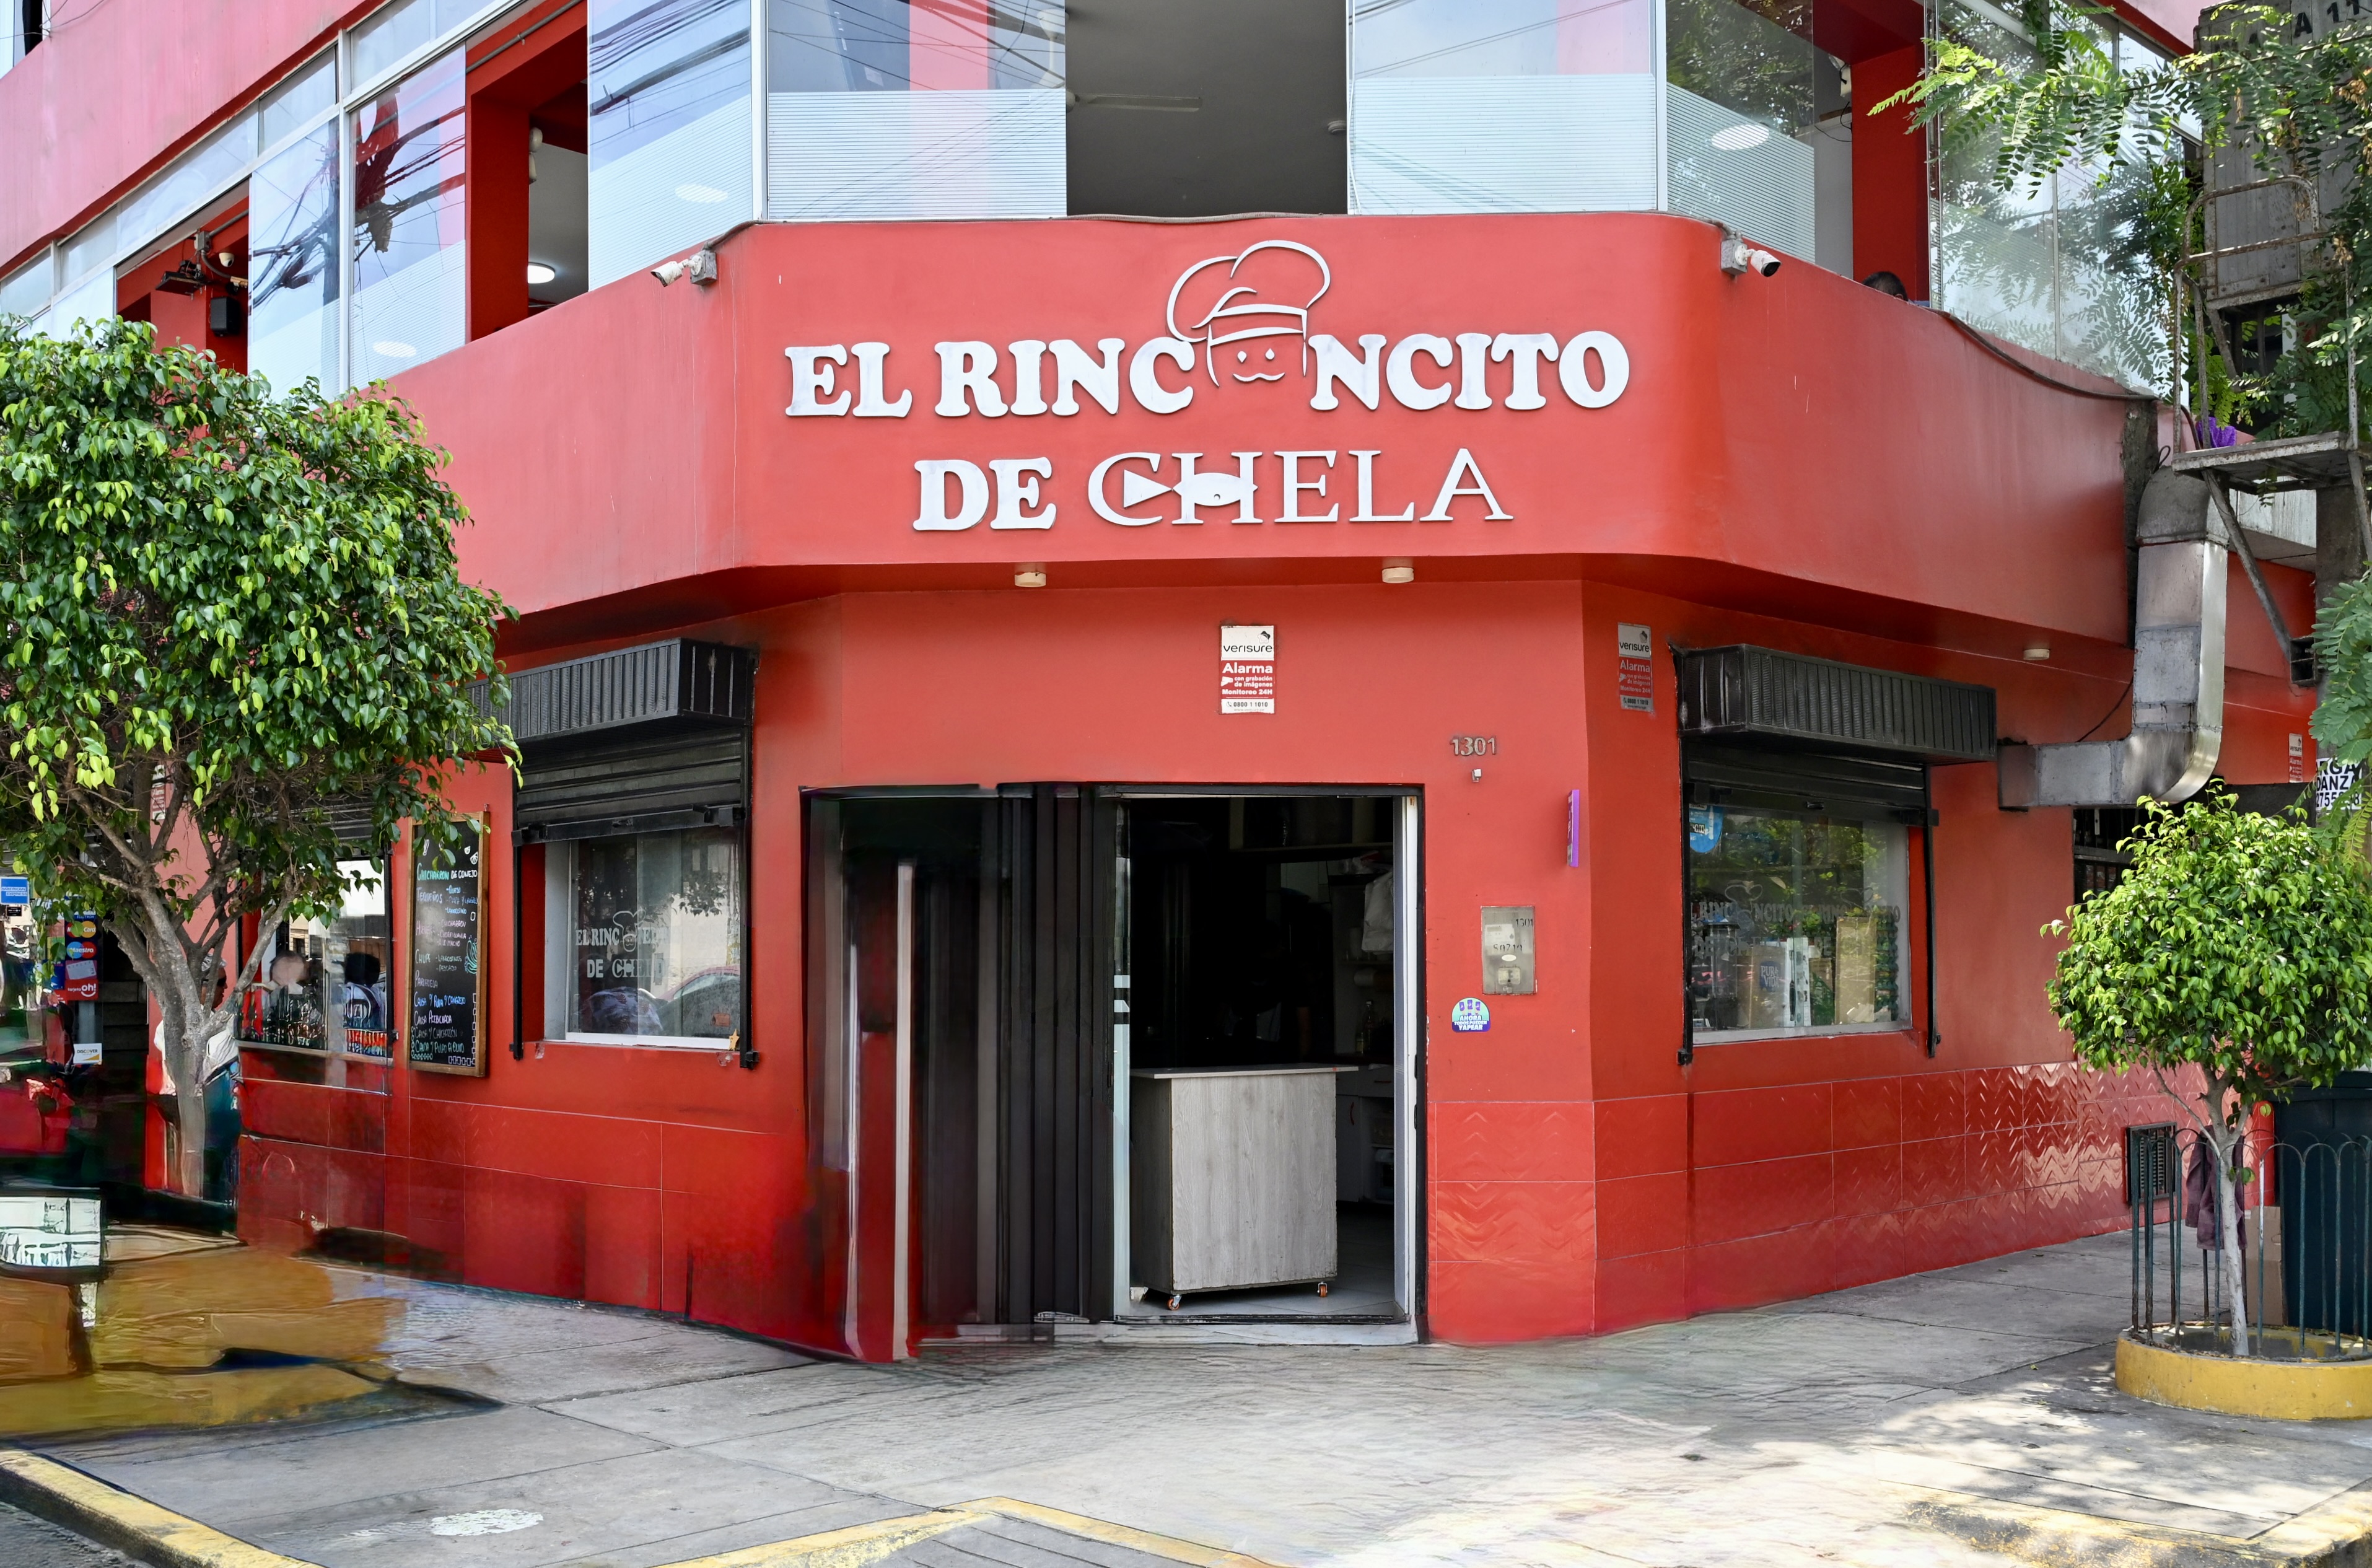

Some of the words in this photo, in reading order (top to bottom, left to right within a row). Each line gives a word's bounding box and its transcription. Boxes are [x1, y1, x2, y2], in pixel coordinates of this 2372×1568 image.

[784, 342, 912, 418] EL
[913, 457, 1057, 531] DE
[1088, 447, 1514, 527] CHELA
[1619, 642, 1650, 652] verisure
[1222, 662, 1273, 674] Alarma
[1619, 659, 1651, 673] Alarma
[1450, 736, 1497, 756] 1301
[575, 929, 589, 945] EL
[587, 959, 604, 978] DE
